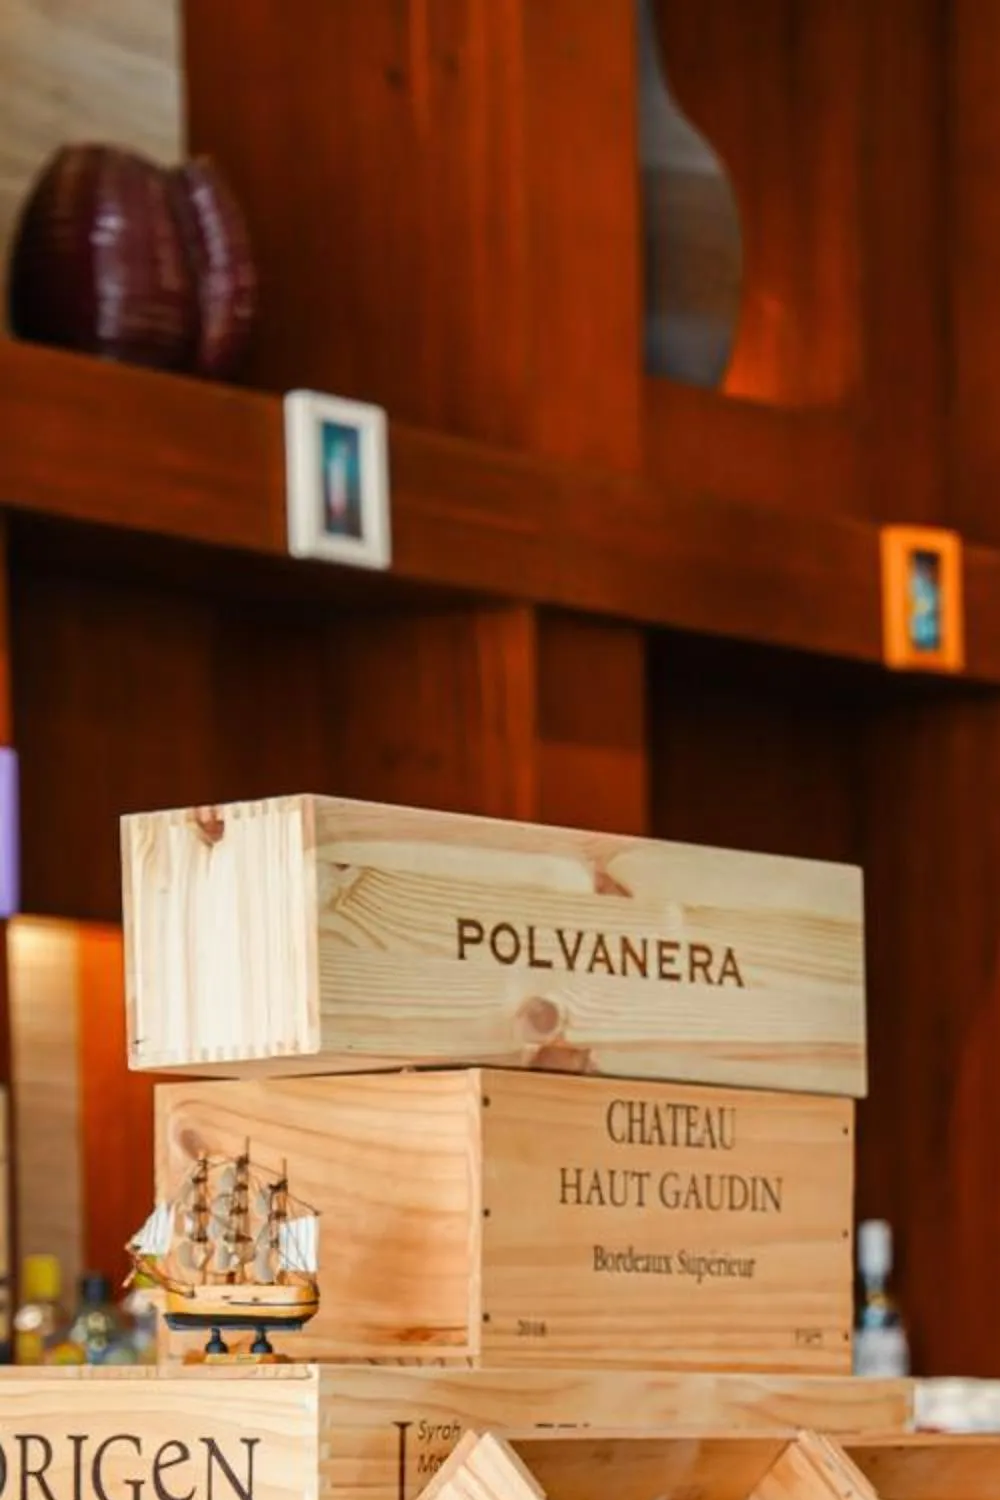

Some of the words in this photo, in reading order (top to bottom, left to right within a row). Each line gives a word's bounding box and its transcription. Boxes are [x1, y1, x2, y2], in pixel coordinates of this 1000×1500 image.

[457, 918, 745, 988] POLVANERA
[606, 1099, 737, 1150] CHATEAU
[559, 1167, 651, 1208] HAUT
[658, 1172, 783, 1213] GAUDIN
[593, 1245, 673, 1274] Bordeaux
[417, 1419, 462, 1441] Syrah
